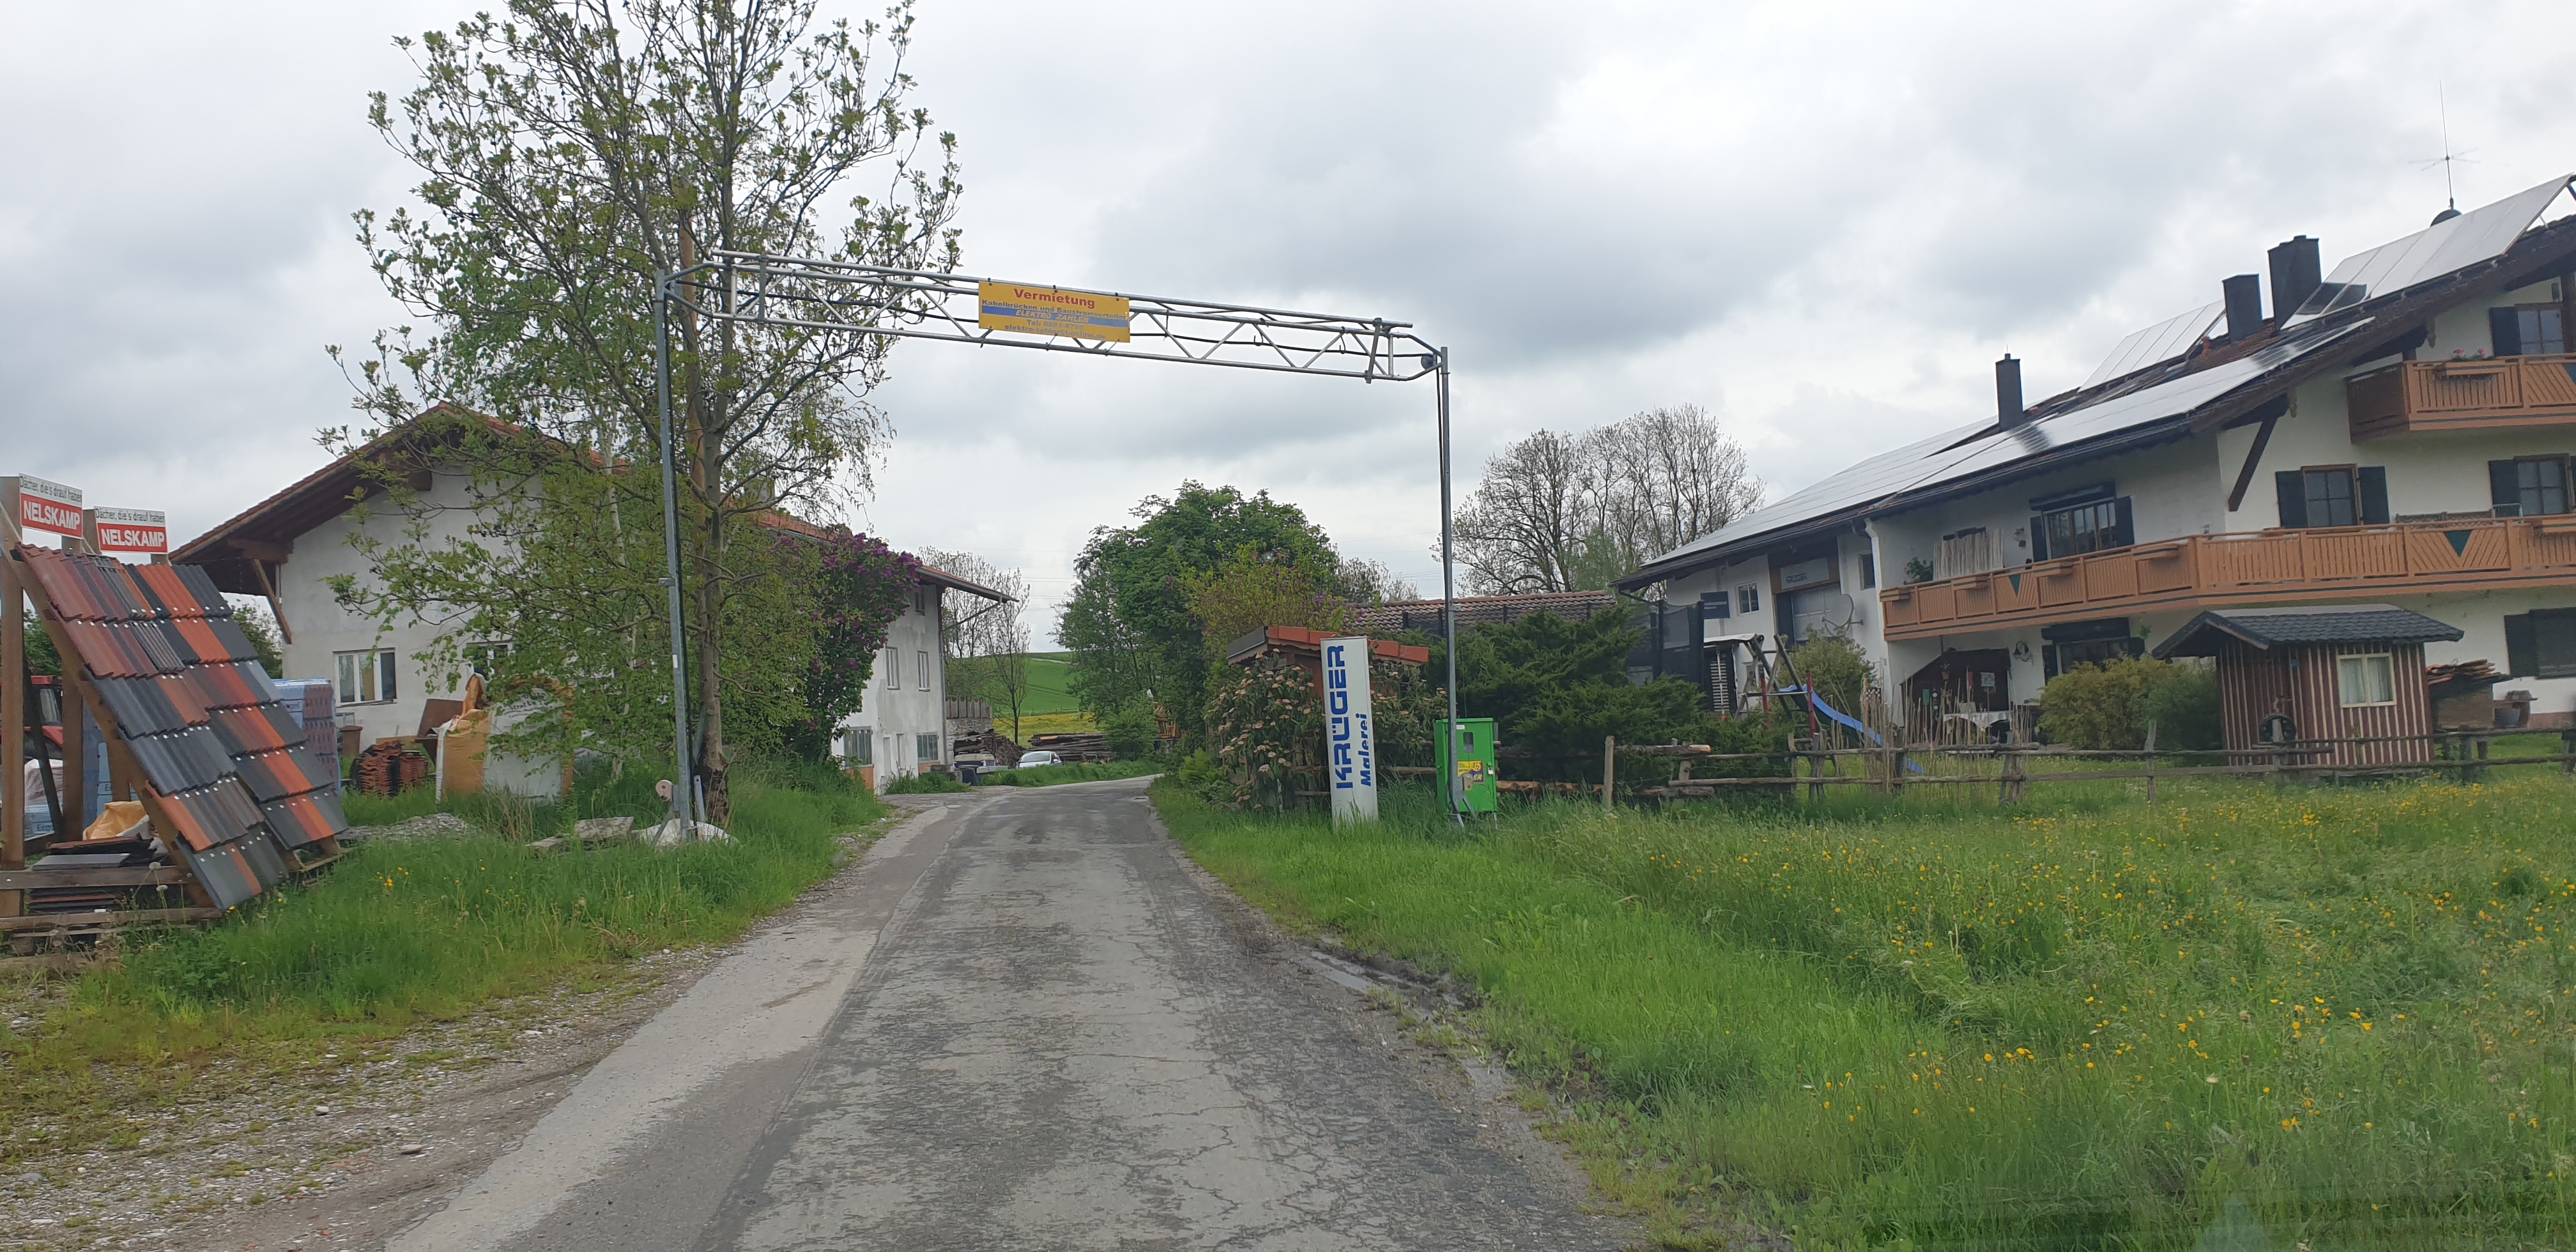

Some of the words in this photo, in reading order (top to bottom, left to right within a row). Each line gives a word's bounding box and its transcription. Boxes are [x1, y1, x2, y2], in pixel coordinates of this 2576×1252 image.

[981, 299, 1038, 311] Kabelbrücken
[1014, 288, 1095, 309] Vermietung
[1015, 310, 1052, 319] ELEKTRO
[24, 500, 80, 530] NELSKAMP
[133, 511, 149, 521] drauf
[100, 528, 165, 547] NELSKAMP
[1327, 645, 1353, 789] KRÜGER
[1355, 713, 1372, 787] Malerei
